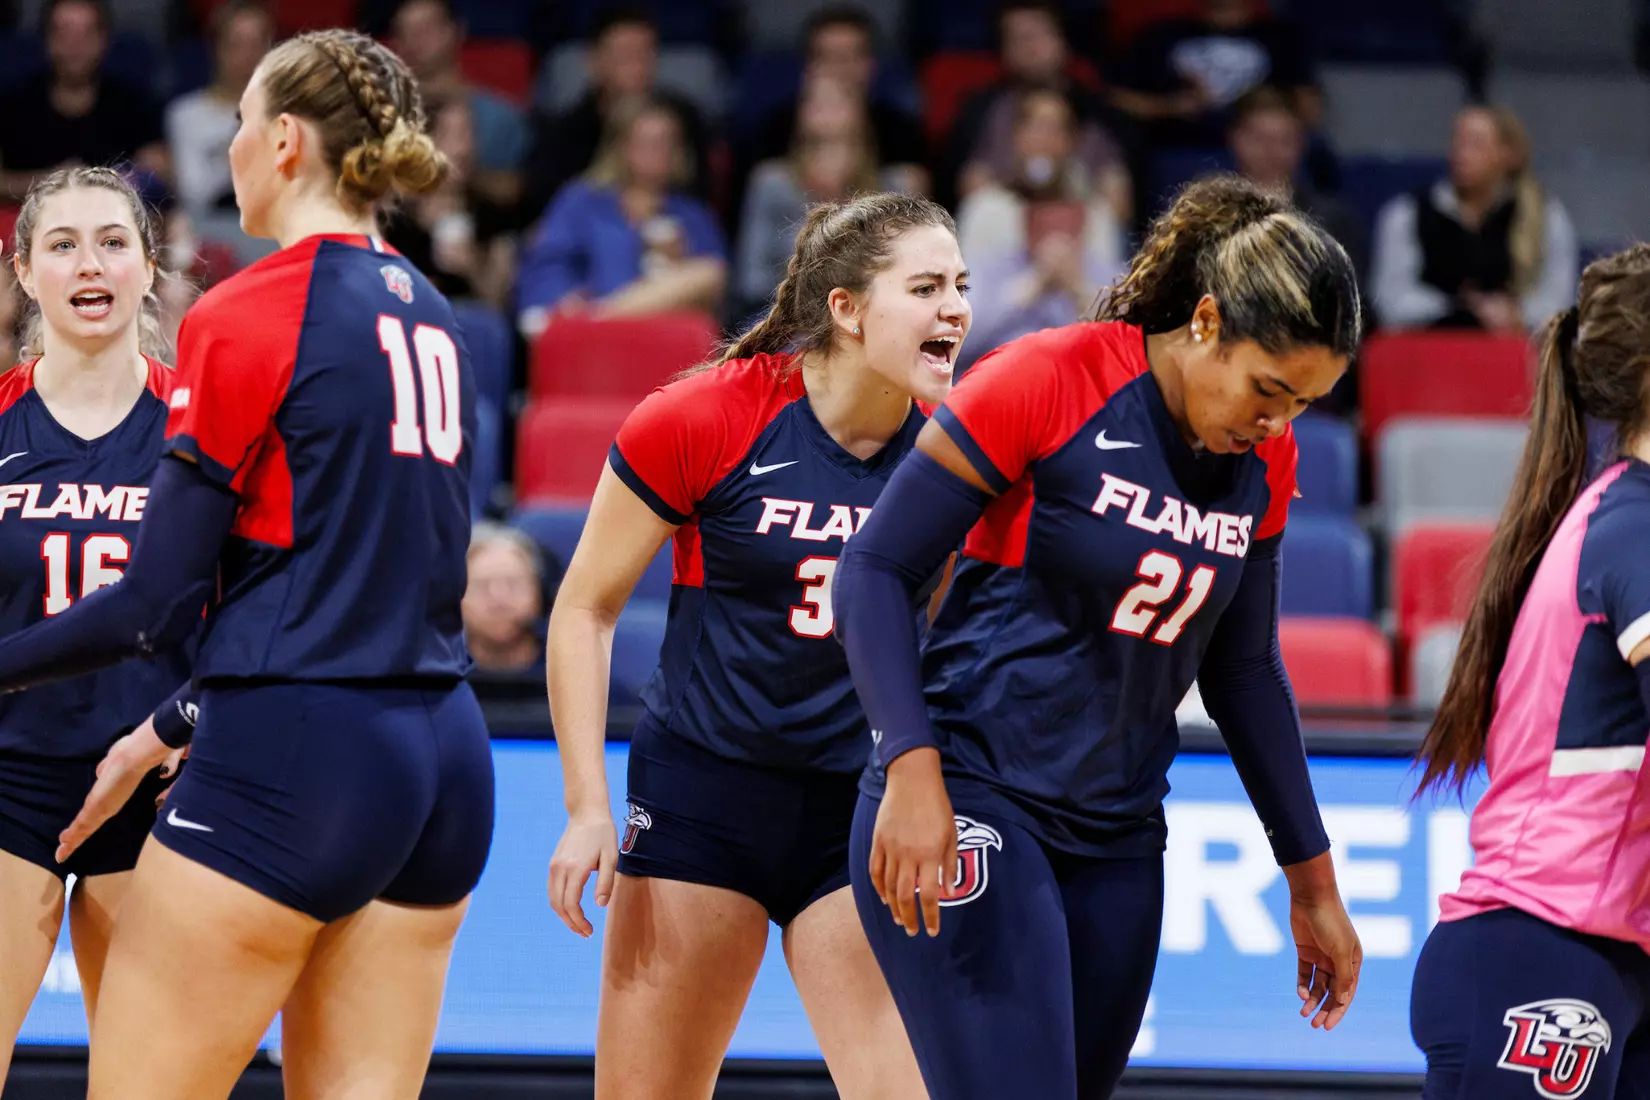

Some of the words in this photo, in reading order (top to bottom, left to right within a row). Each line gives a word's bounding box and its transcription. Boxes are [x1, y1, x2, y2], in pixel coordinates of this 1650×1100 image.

[376, 312, 463, 466] 10
[0, 483, 150, 521] FLAME
[1091, 472, 1253, 558] FLAMES
[40, 532, 131, 617] 16
[788, 555, 839, 639] 3
[1108, 549, 1217, 646] 21
[1497, 1004, 1606, 1100] LU
